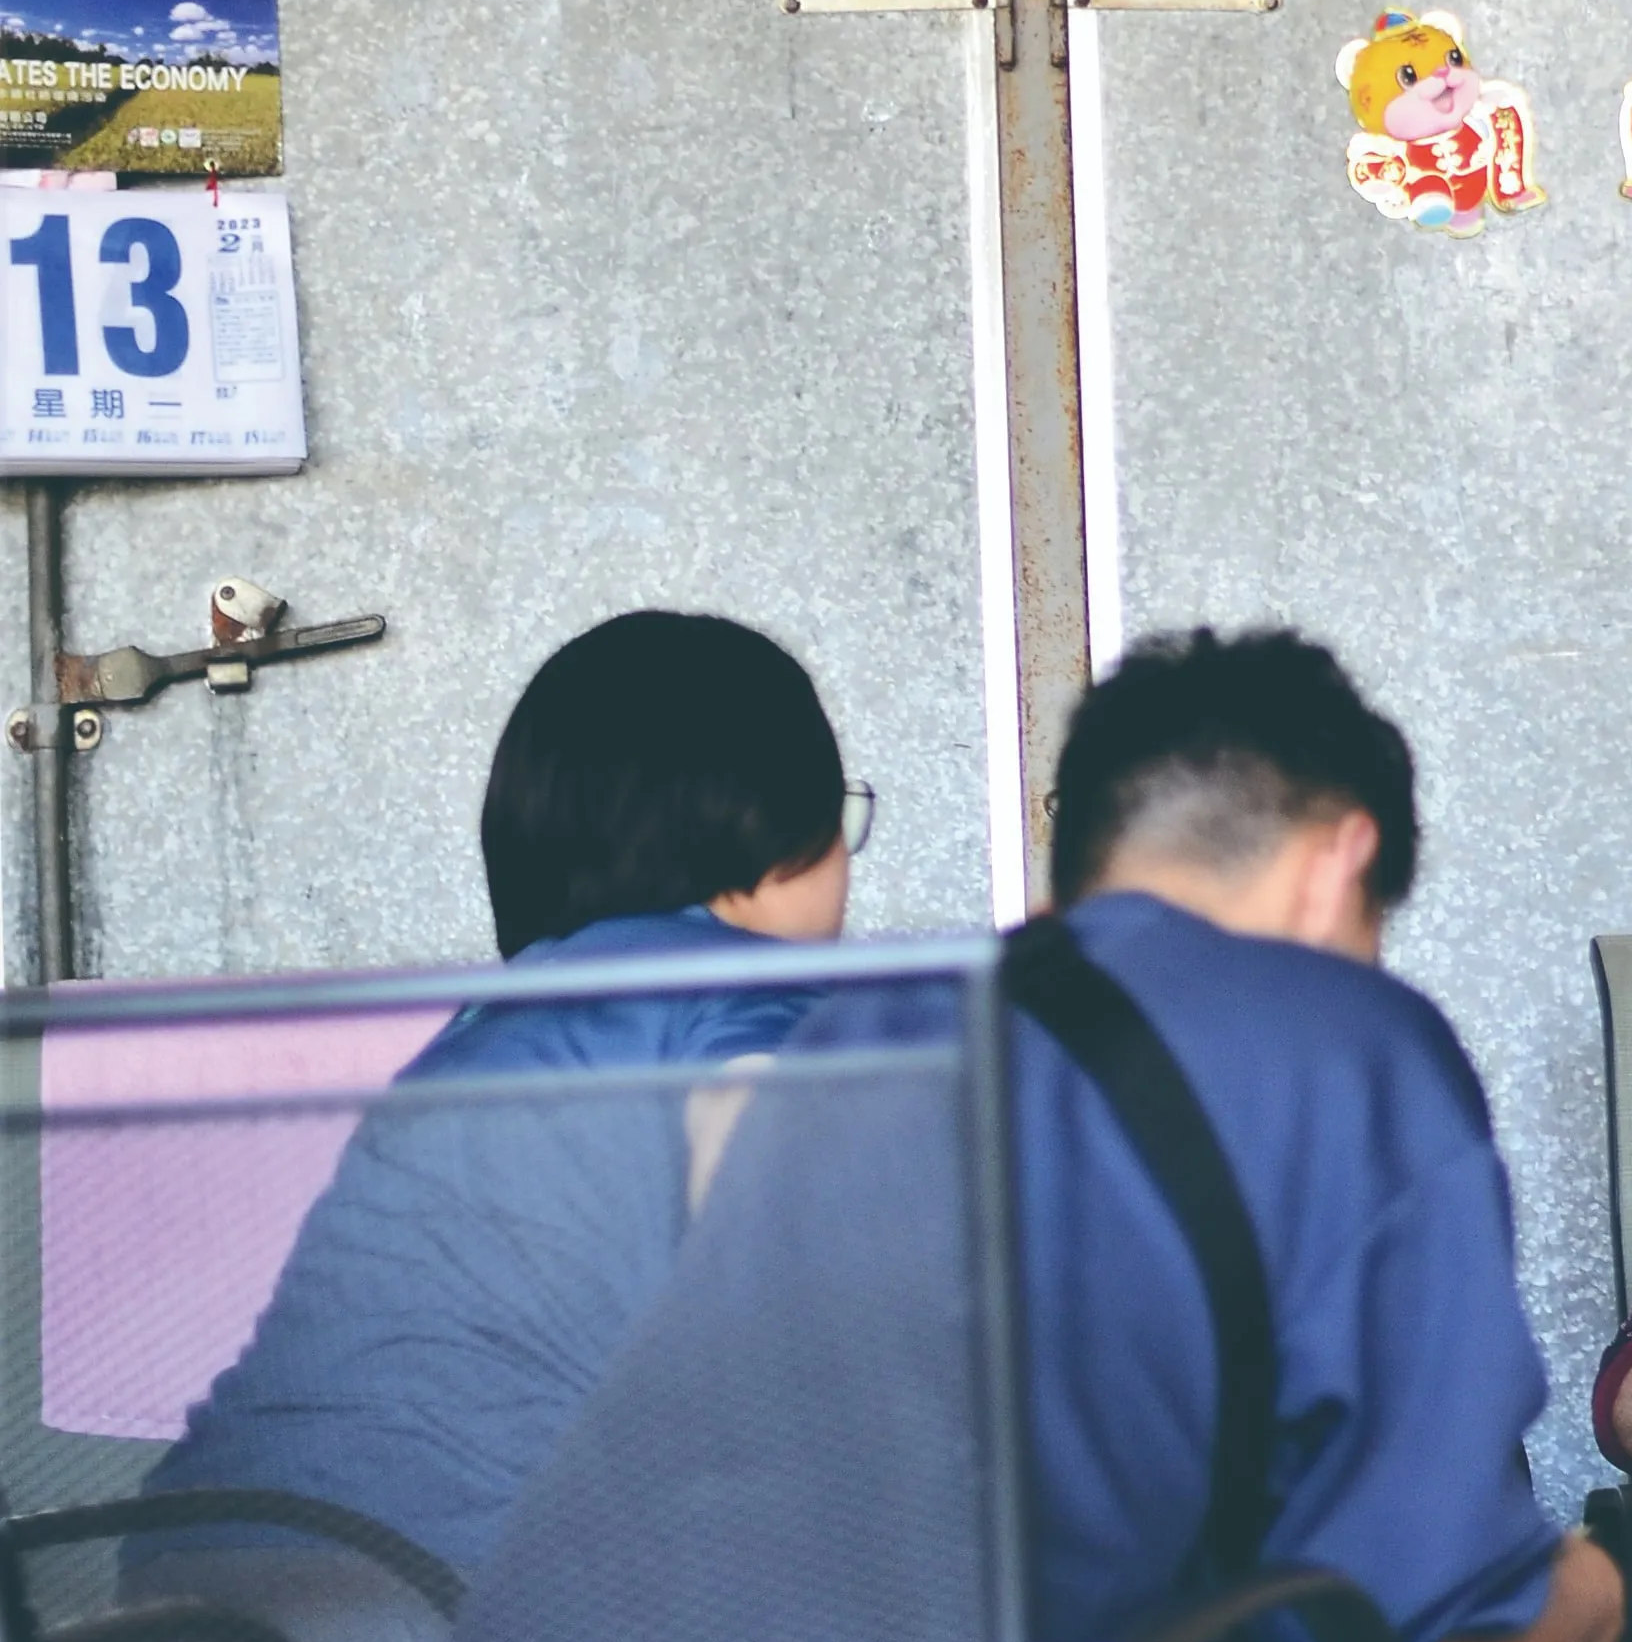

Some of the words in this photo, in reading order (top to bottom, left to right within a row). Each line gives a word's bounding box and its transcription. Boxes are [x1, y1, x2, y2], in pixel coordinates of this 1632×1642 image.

[64, 61, 113, 89] THE
[119, 64, 249, 92] ECONOMY
[217, 217, 261, 230] 2023
[9, 214, 190, 378] 13
[33, 388, 182, 419] 星期一
